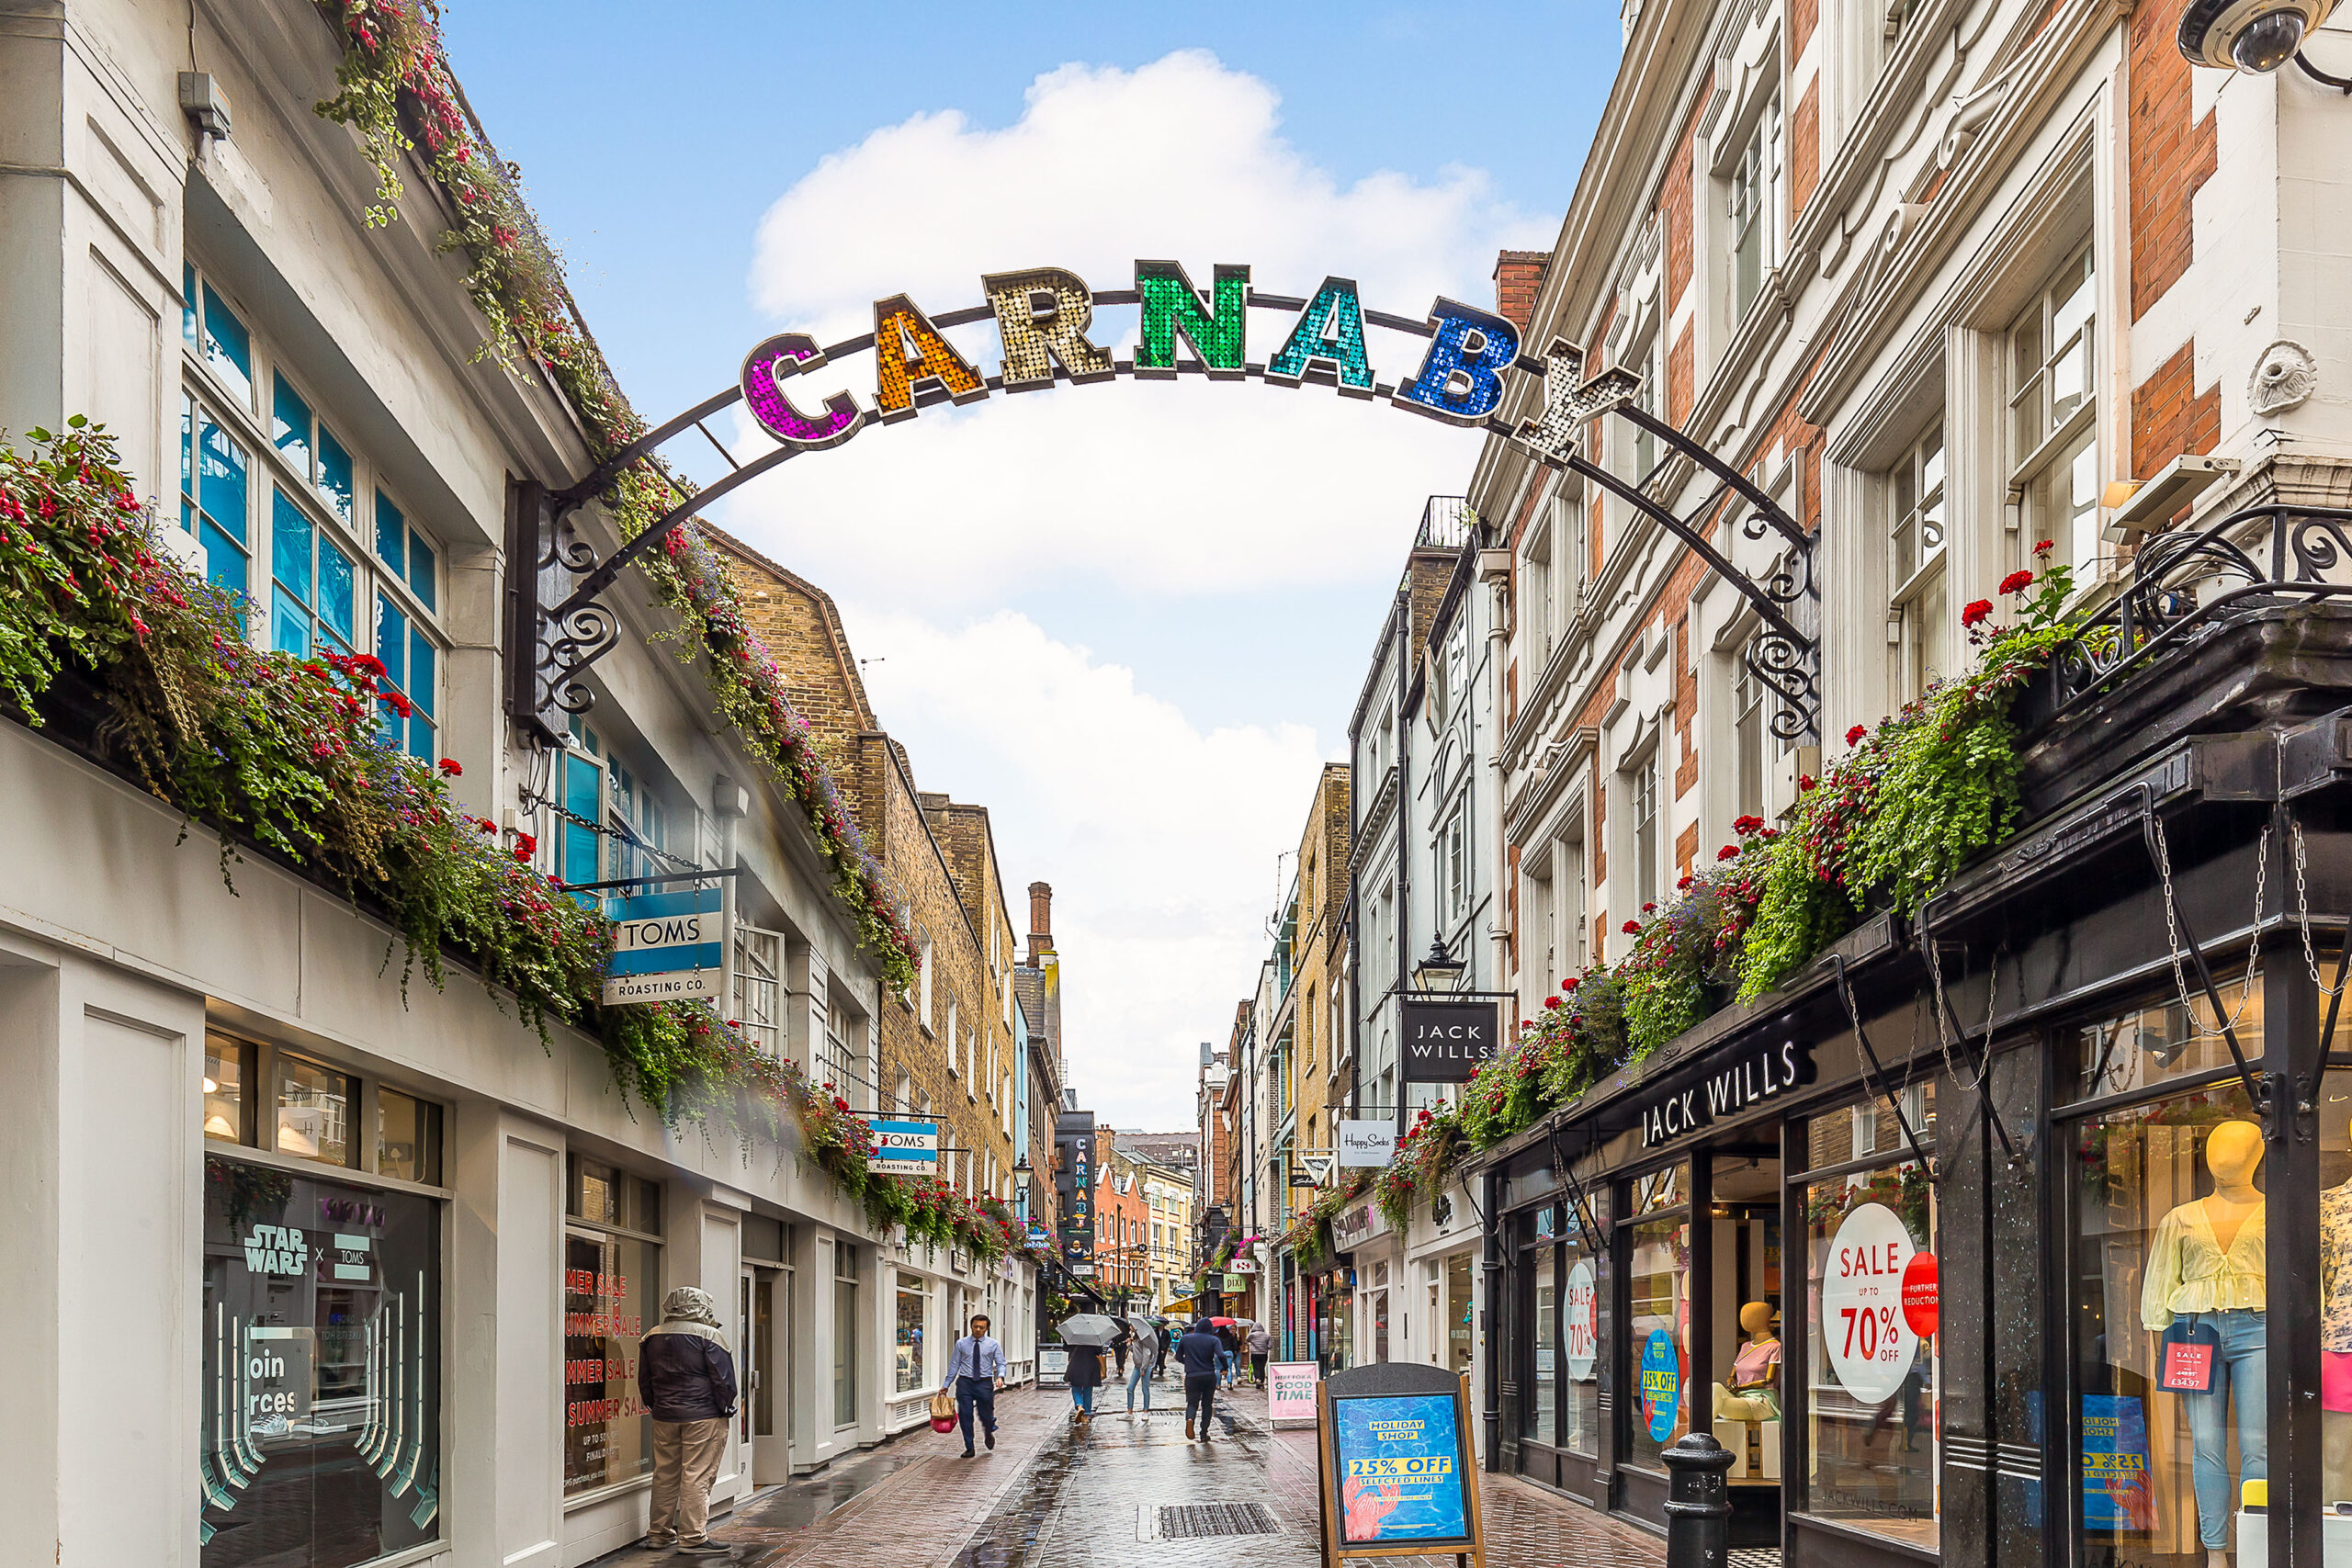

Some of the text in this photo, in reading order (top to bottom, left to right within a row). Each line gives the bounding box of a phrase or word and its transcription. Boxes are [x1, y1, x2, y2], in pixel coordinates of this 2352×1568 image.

[740, 260, 1645, 463] CARNABY
[624, 919, 700, 946] TOMS
[619, 979, 706, 996] ROASTING CO.
[1418, 1025, 1481, 1039] JACK
[1411, 1044, 1488, 1059] WILLS
[1642, 1041, 1794, 1147] JACK WILLS
[880, 1134, 925, 1147] TOMS
[244, 1224, 308, 1252] STAR
[244, 1247, 308, 1276] WARS
[341, 1250, 364, 1265] TOMS
[1840, 1242, 1899, 1278] SALE
[597, 1272, 626, 1299] SALE
[1859, 1287, 1879, 1296] UP TO
[1910, 1282, 1937, 1292] FURTHER
[1569, 1287, 1590, 1307] SALE
[612, 1314, 640, 1337] SALE
[1841, 1306, 1899, 1360] 70%
[1569, 1324, 1591, 1356] 70%
[1881, 1349, 1900, 1361] OFF
[606, 1358, 635, 1381] SALE
[1275, 1382, 1313, 1390] GOOD
[1661, 1372, 1675, 1391] OFF
[2171, 1378, 2200, 1387] £34.97
[1275, 1390, 1313, 1401] TIME
[568, 1398, 620, 1427] SUMMER
[1371, 1420, 1423, 1430] HOLIDAY
[1382, 1431, 1414, 1440] SHOP
[586, 1449, 602, 1461] FINAL
[1352, 1458, 1449, 1475] 25% OFF
[1361, 1475, 1442, 1485] SELECTED LINES
